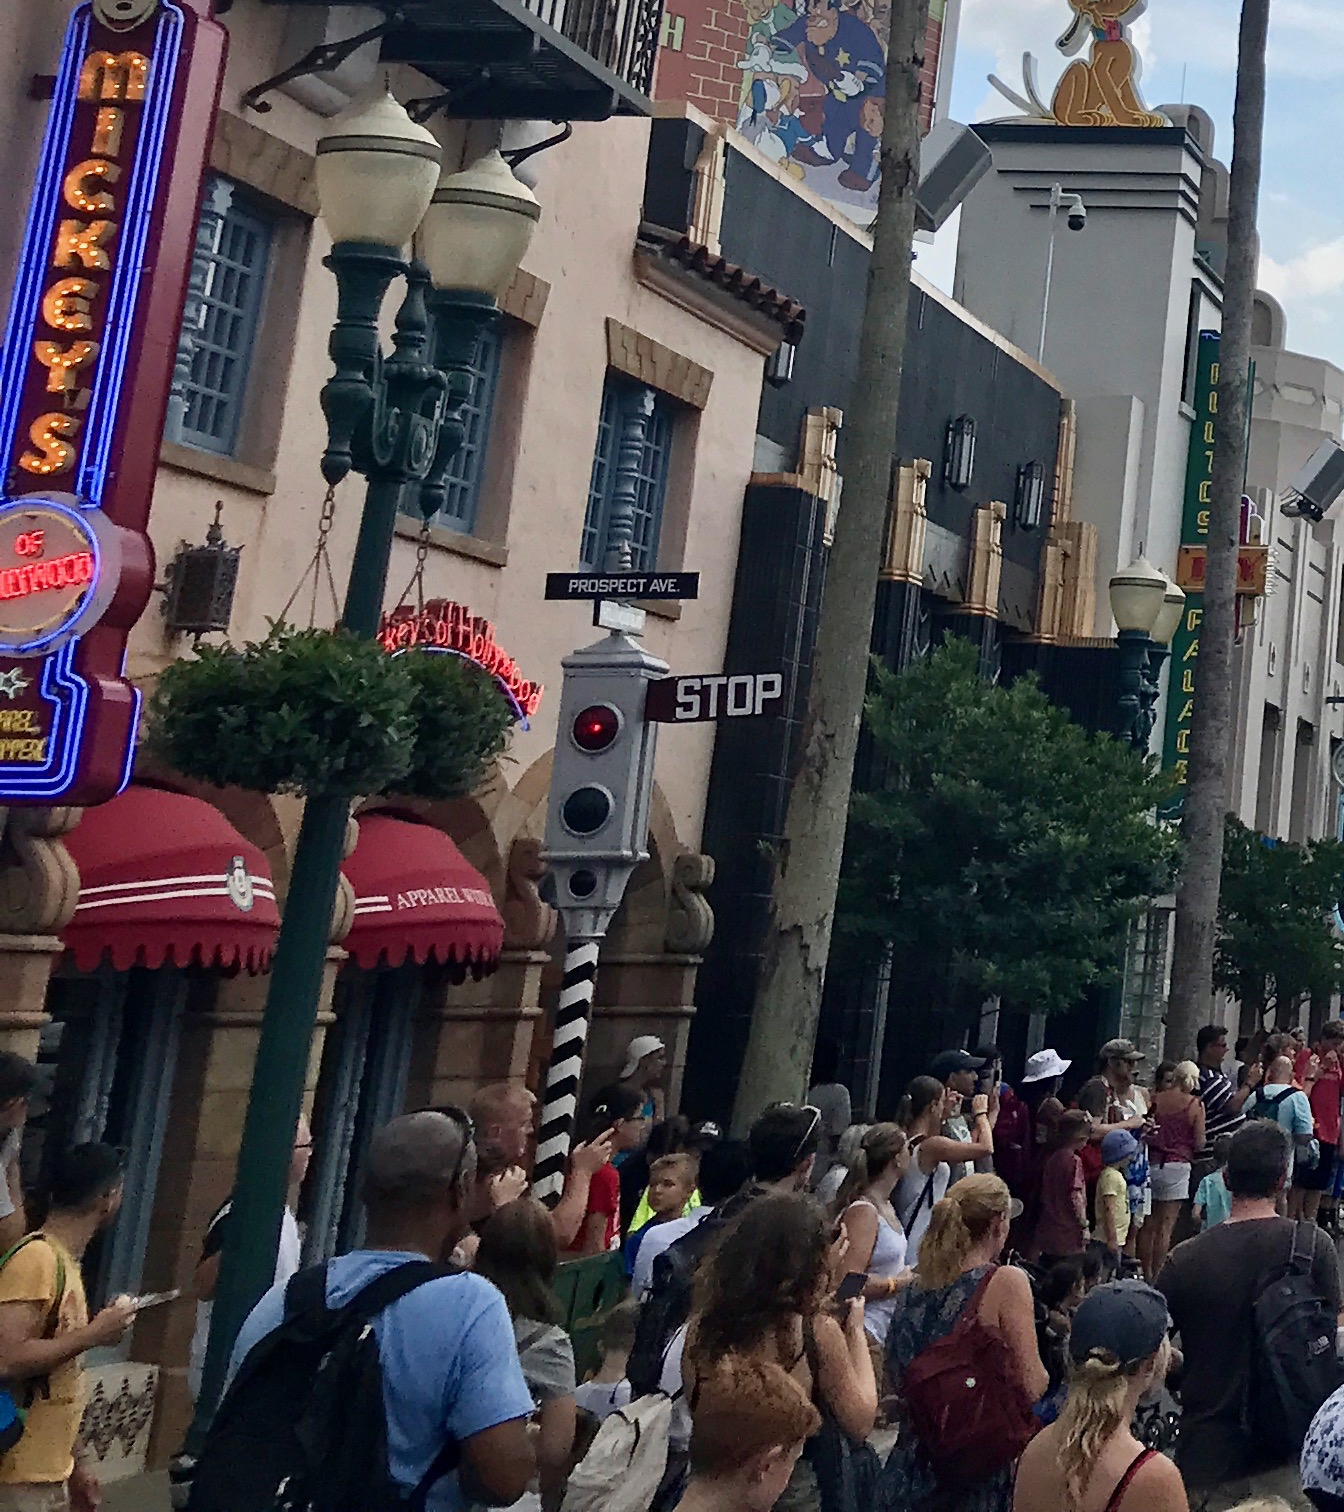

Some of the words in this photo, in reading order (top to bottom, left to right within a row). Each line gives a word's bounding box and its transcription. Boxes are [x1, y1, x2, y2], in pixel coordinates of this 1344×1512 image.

[18, 50, 151, 476] MICKEY'S
[568, 578, 647, 593] PROSPECT
[648, 578, 680, 593] AVE.
[457, 606, 545, 716] Hollywood
[675, 673, 782, 719] STOP
[397, 887, 466, 909] APPAREL
